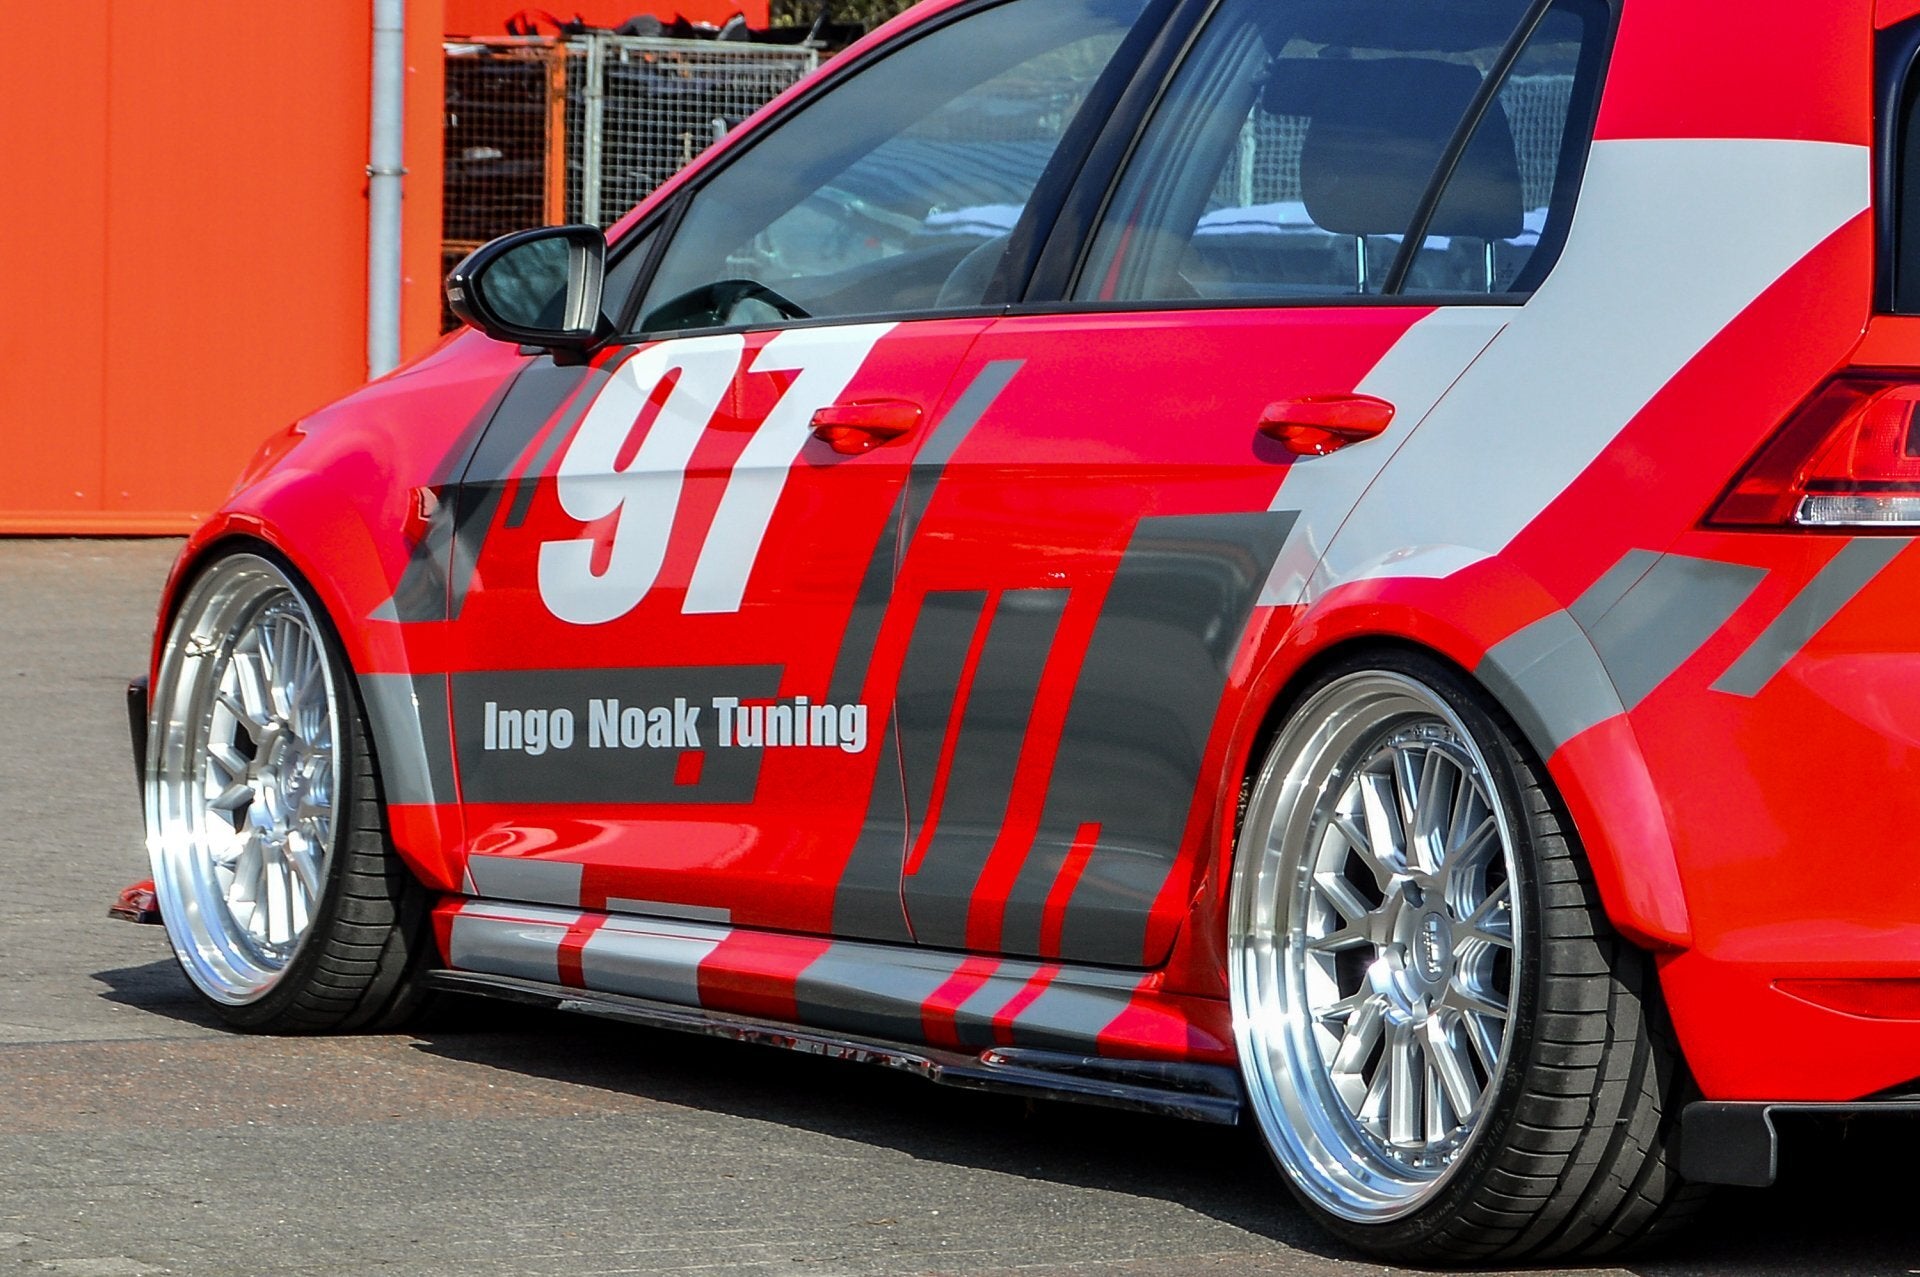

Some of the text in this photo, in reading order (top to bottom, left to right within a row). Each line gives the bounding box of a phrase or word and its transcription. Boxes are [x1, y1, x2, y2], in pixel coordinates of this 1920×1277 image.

[538, 322, 898, 624] 97
[484, 695, 868, 756] Ingo Noak Tuning
